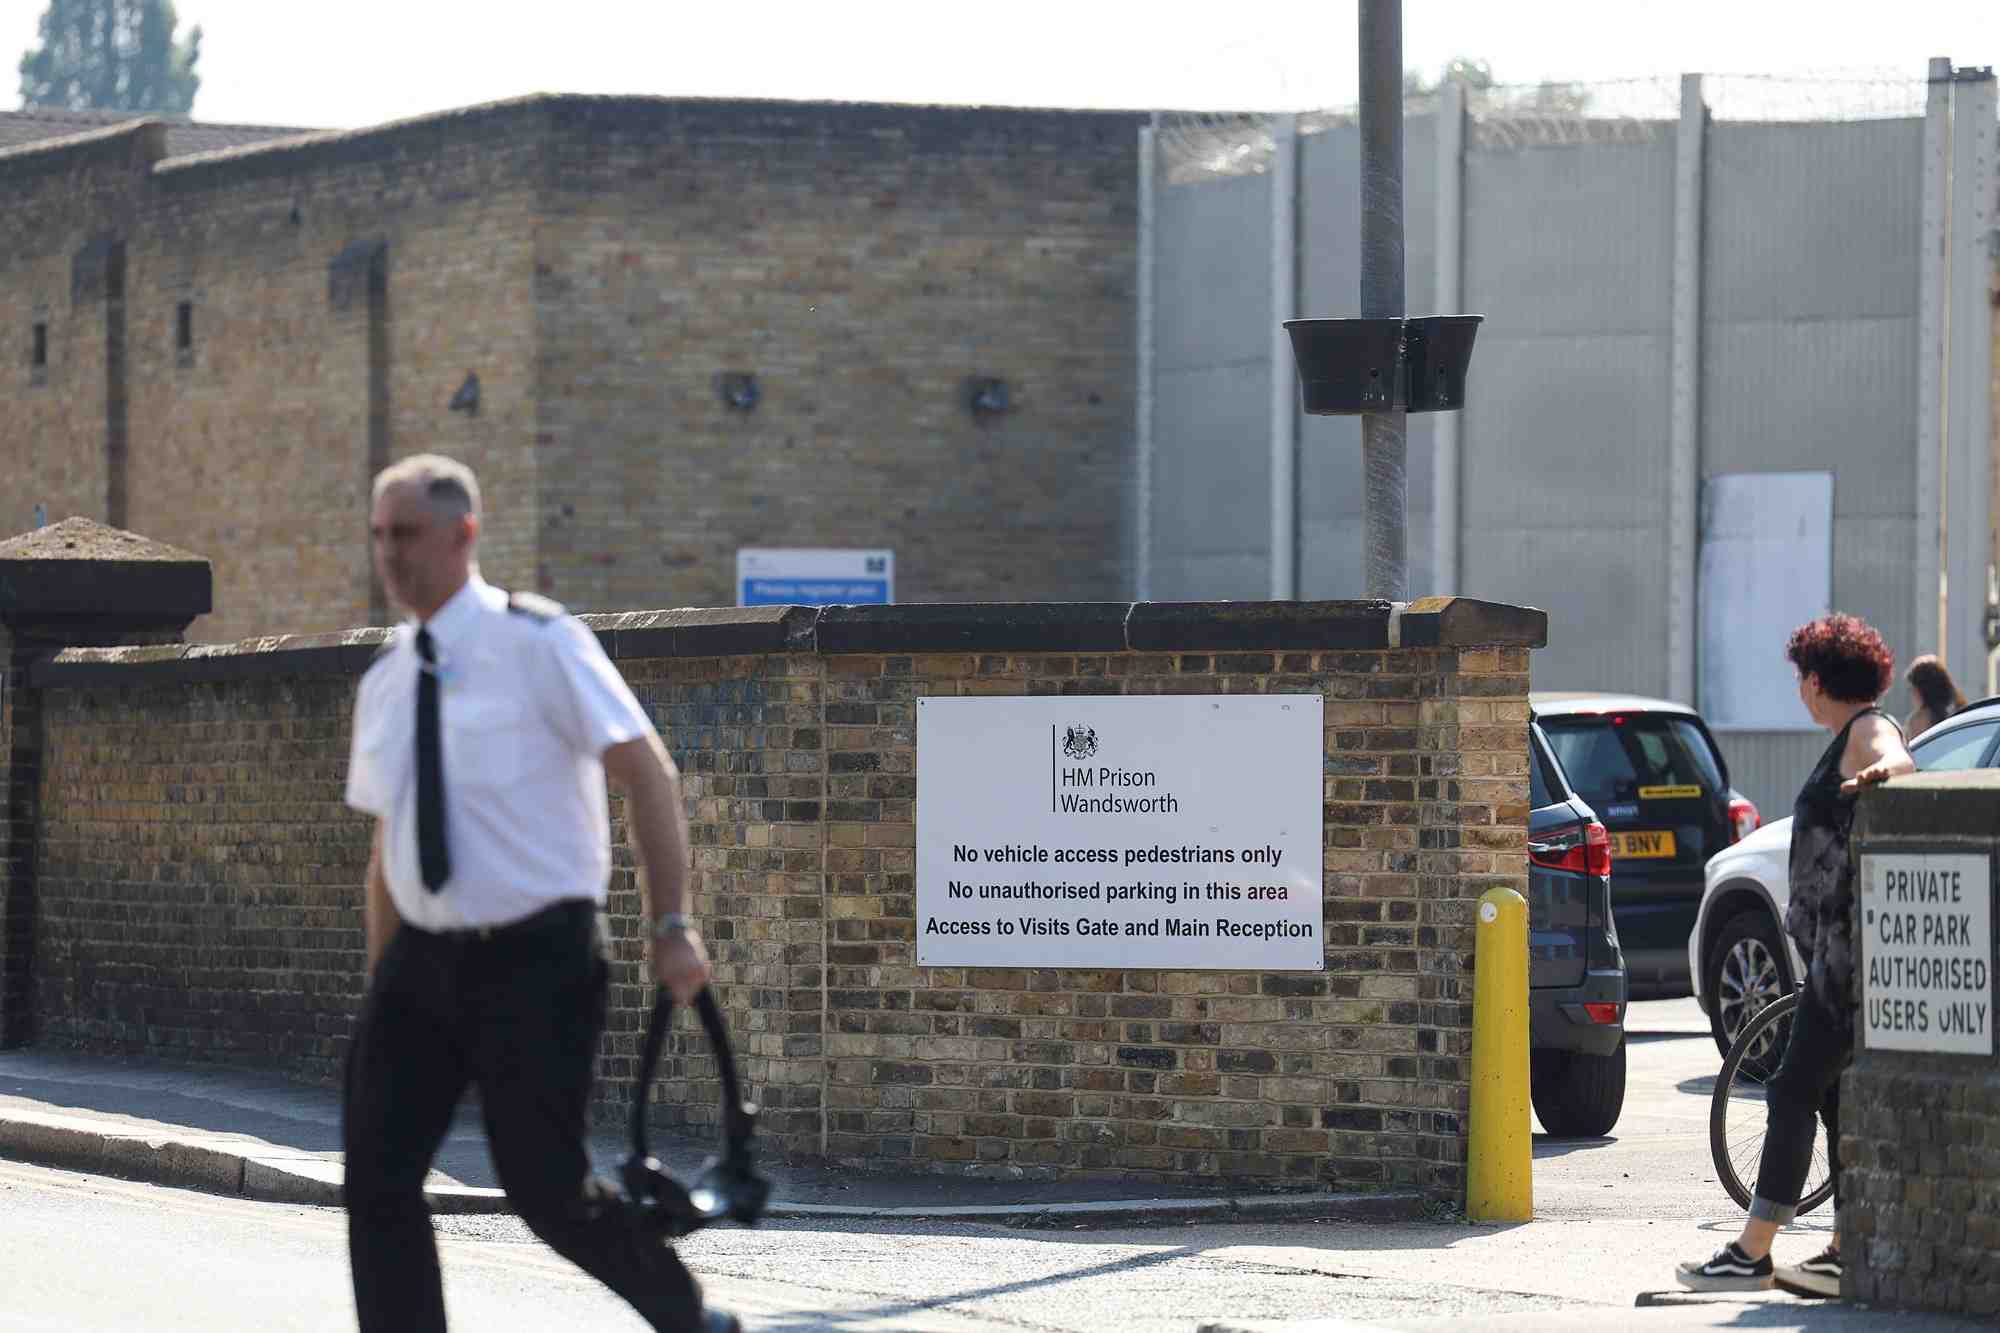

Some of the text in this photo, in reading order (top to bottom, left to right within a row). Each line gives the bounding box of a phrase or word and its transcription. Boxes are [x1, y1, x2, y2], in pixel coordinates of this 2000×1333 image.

[1063, 768, 1155, 786] HM Prison
[1061, 793, 1177, 813] Wandsworth
[954, 845, 1282, 867] No vehicle access pedestrians only
[949, 880, 1288, 904] No unauthorised parking in this area
[1886, 870, 1961, 902] PRIVATE
[926, 917, 1312, 941] Access to Visits Gate and Main Reception
[1880, 912, 1970, 946] CAR PARK
[1869, 957, 1986, 990] AUTHORISED
[1869, 998, 1986, 1034] USERS ONLY
